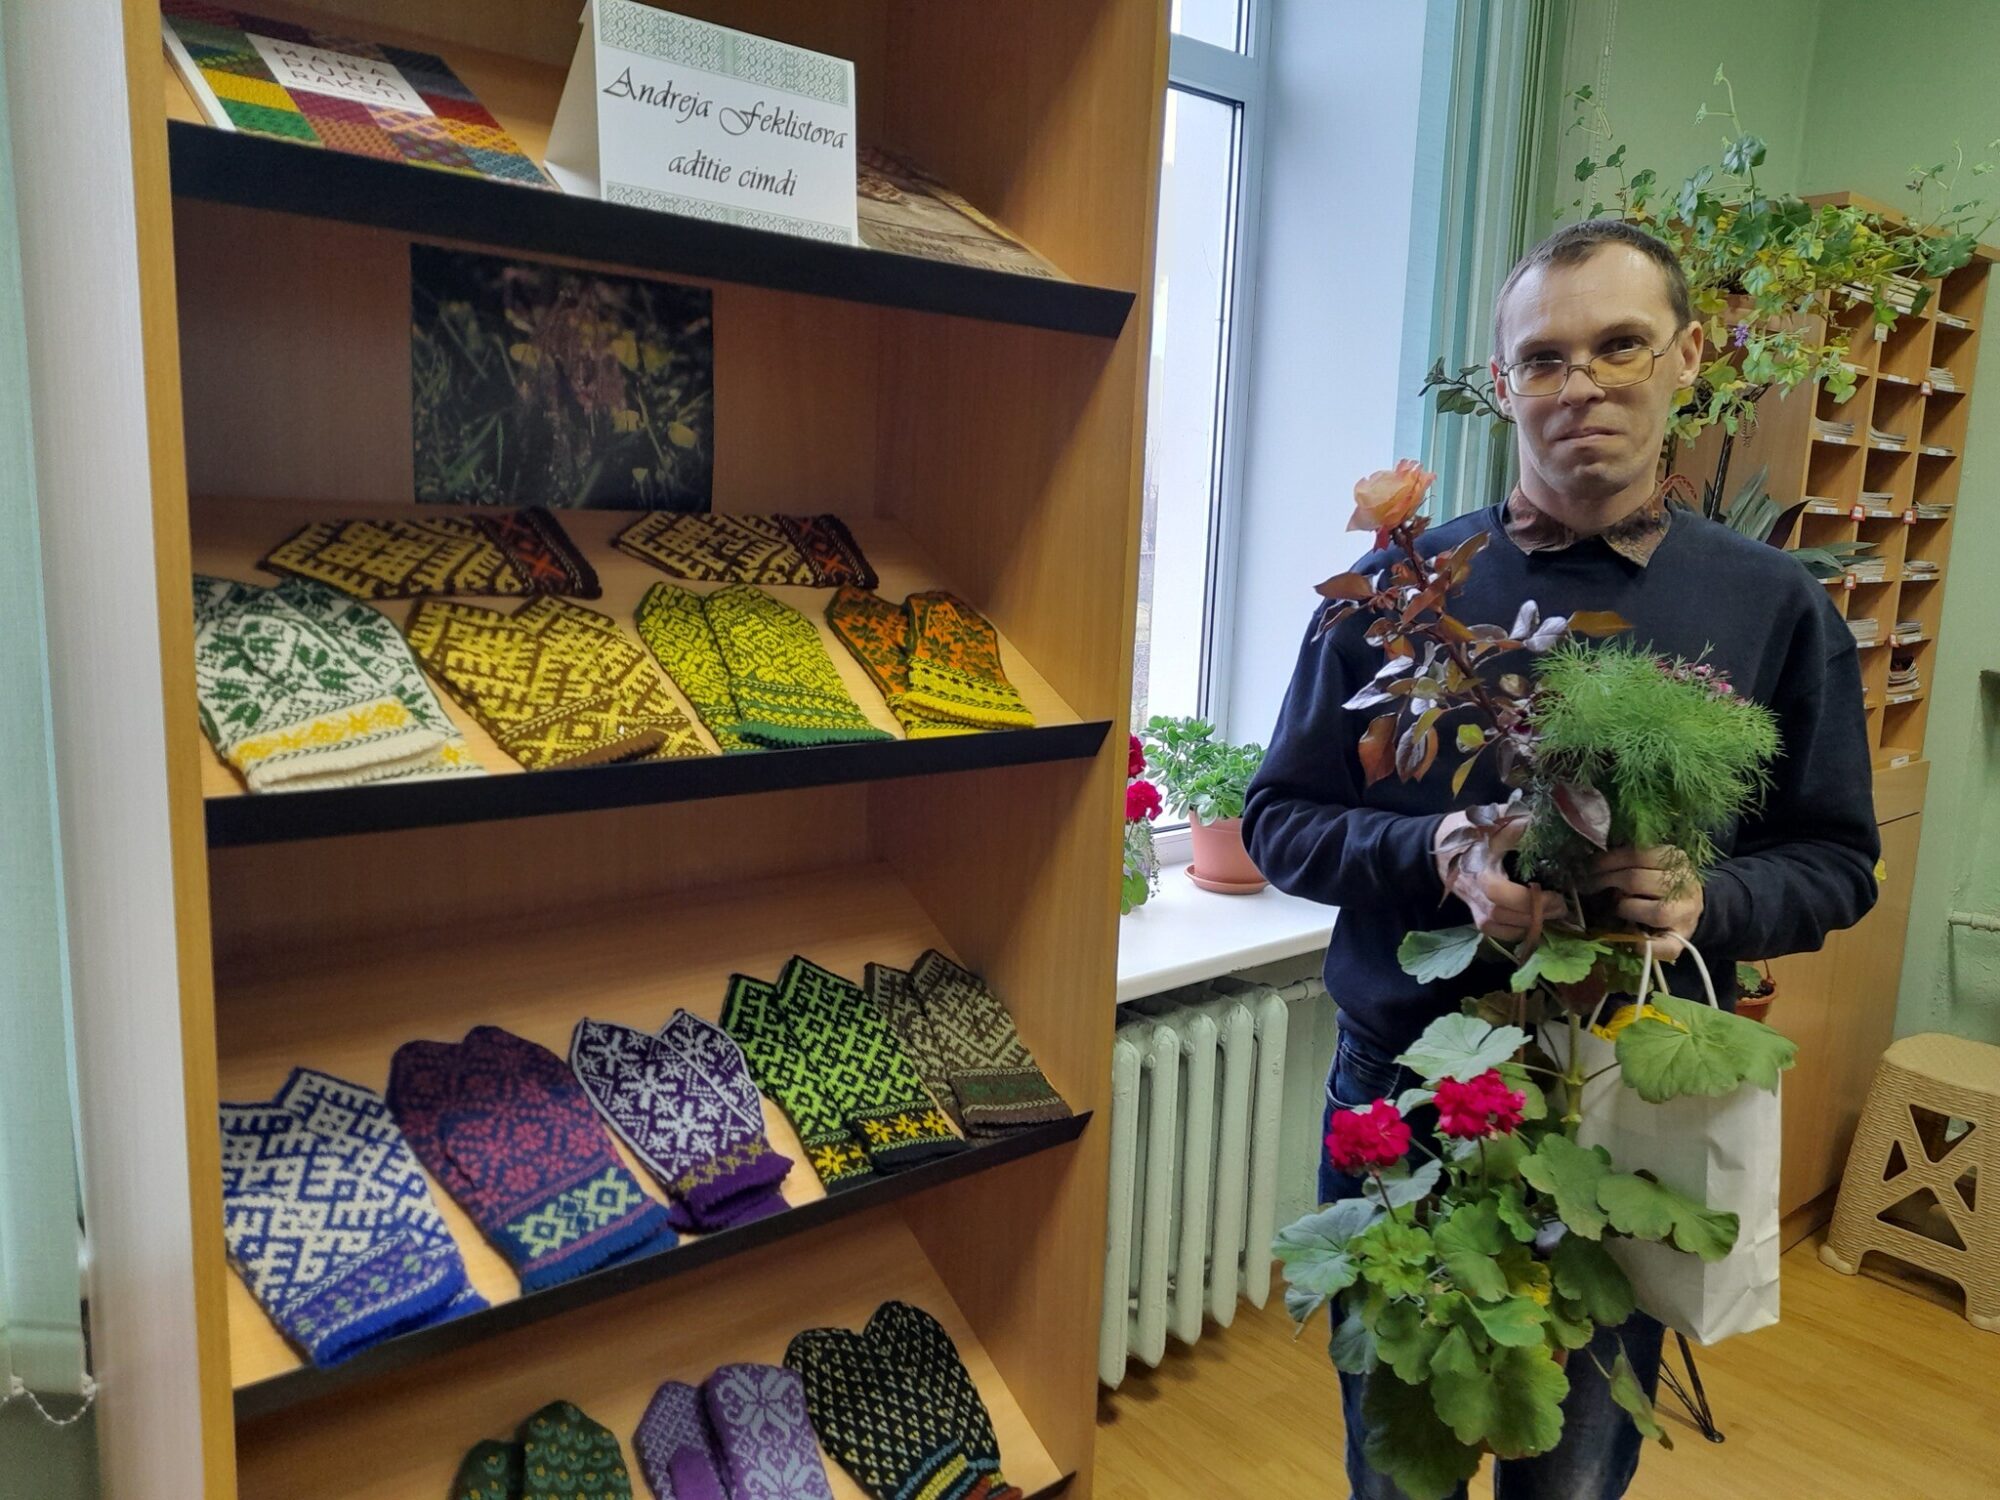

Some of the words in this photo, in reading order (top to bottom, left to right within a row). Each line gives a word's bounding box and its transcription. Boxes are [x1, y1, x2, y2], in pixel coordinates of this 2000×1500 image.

[602, 66, 713, 124] Andreja
[718, 101, 848, 149] Feklistova
[738, 166, 798, 197] cimdi
